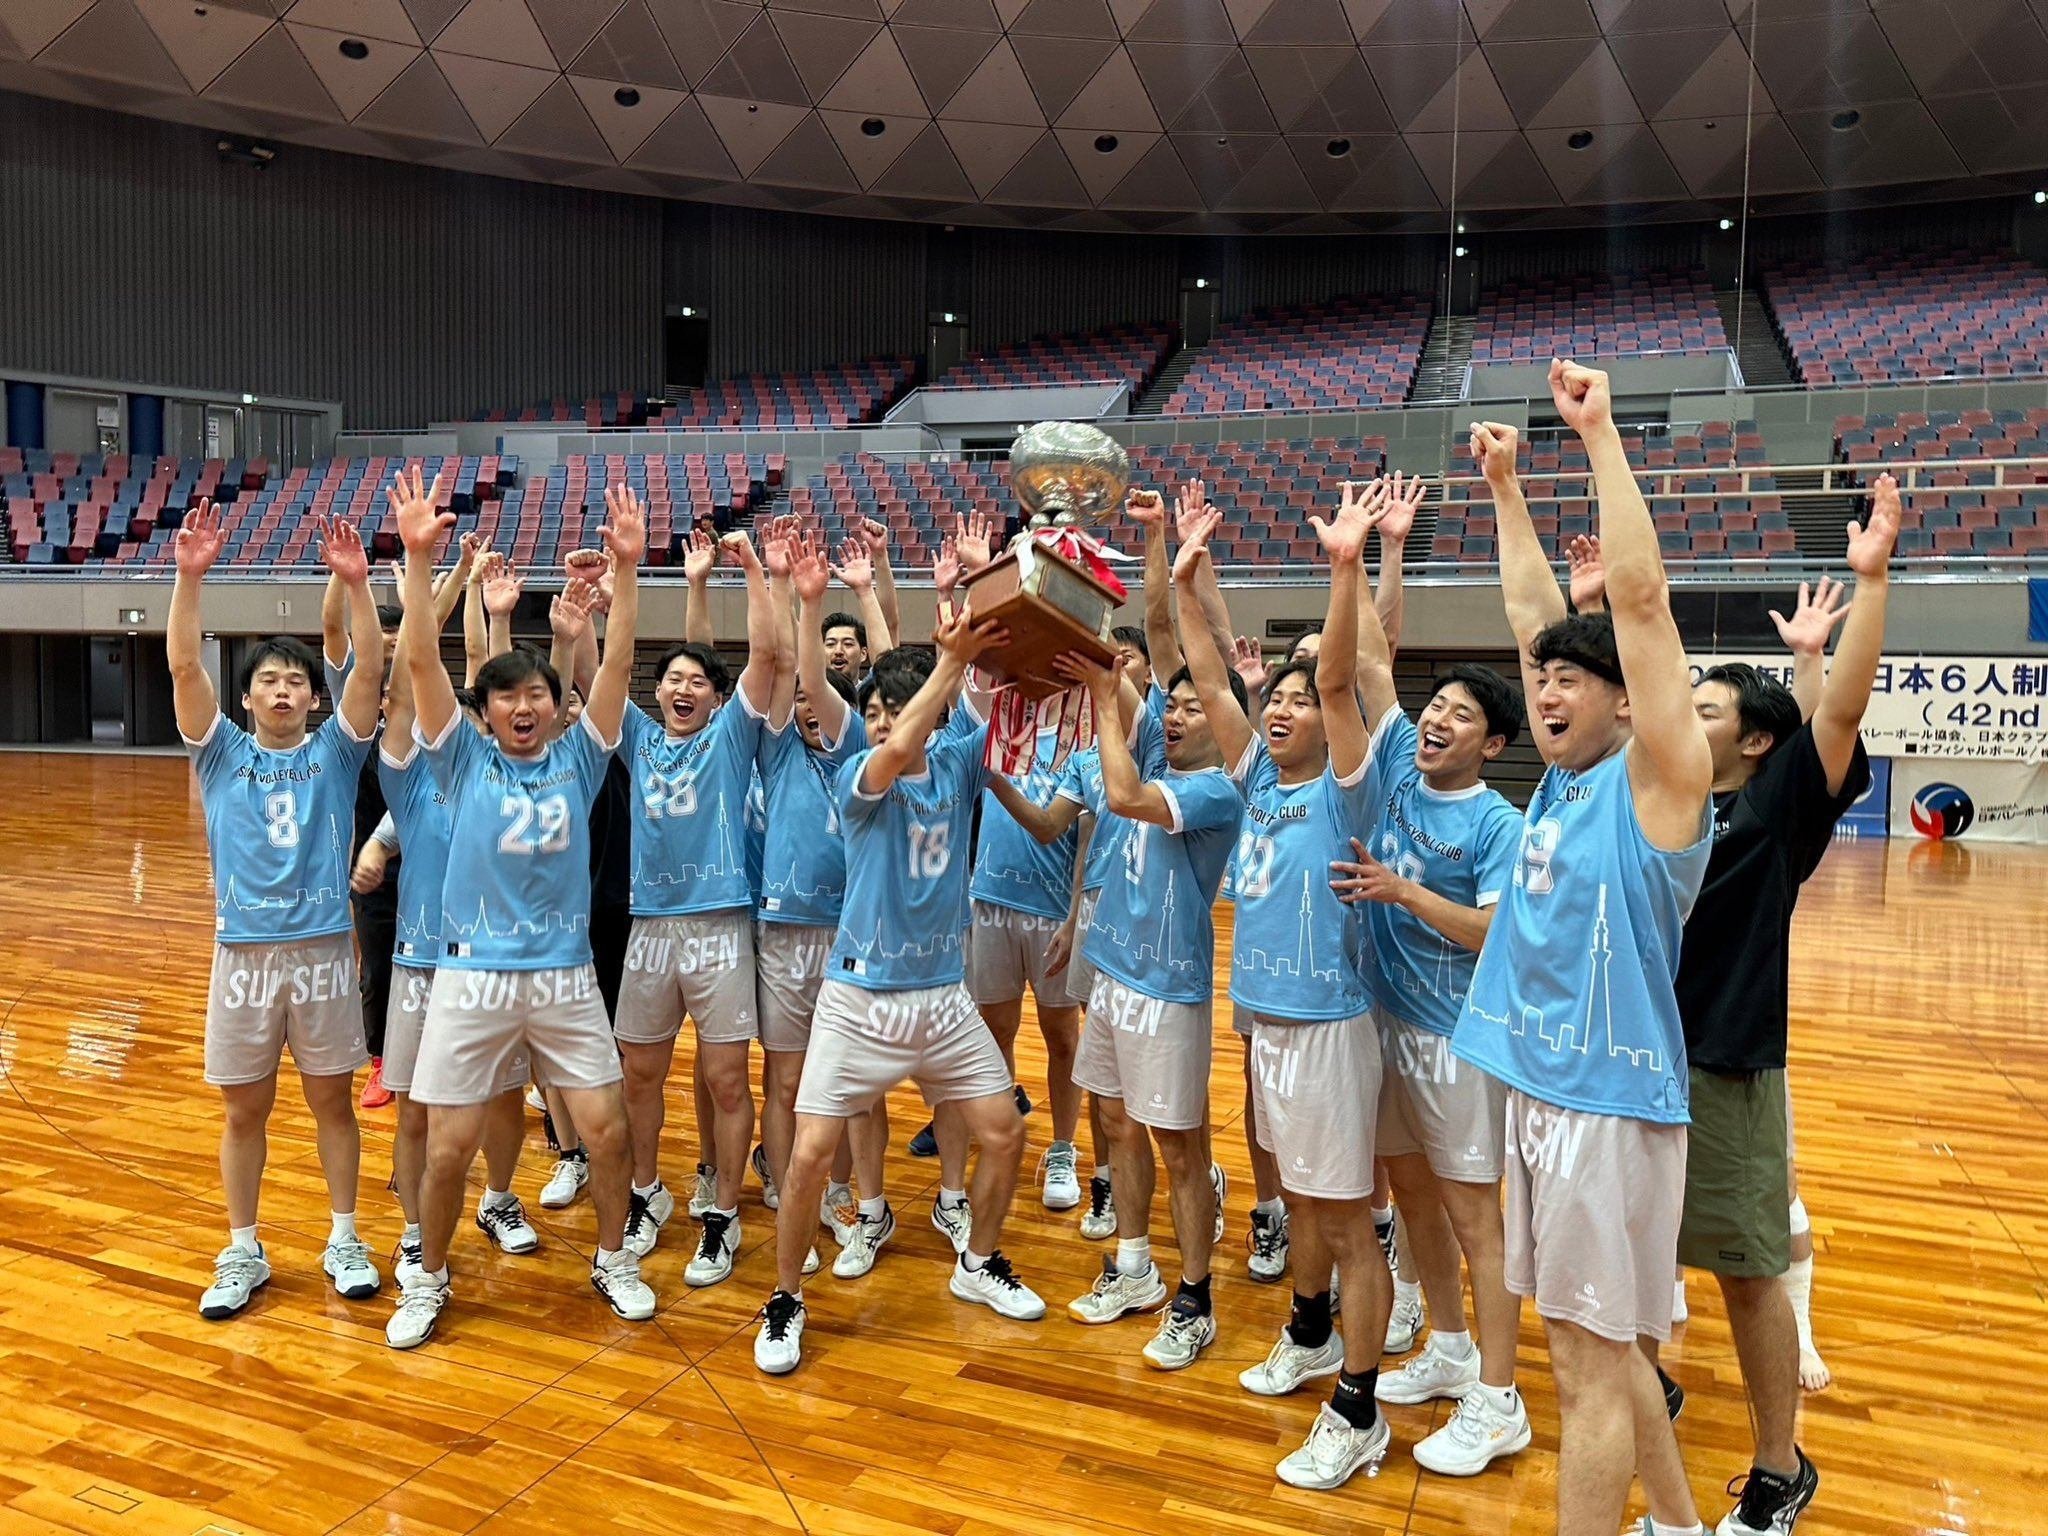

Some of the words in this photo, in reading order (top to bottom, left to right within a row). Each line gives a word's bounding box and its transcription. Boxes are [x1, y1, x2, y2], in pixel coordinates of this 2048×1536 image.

[264, 789, 299, 848] 8
[498, 795, 571, 855] 29
[1279, 804, 1307, 819] CLUB
[1434, 841, 1463, 861] CLUB
[628, 935, 672, 975] SUI
[679, 931, 739, 976] SEN
[225, 969, 279, 1009] SUI
[291, 957, 351, 1006] SEN
[459, 969, 519, 1012] SUI
[531, 965, 592, 1009] SEN
[1110, 987, 1165, 1037] SEN
[1397, 1032, 1457, 1085] SEN
